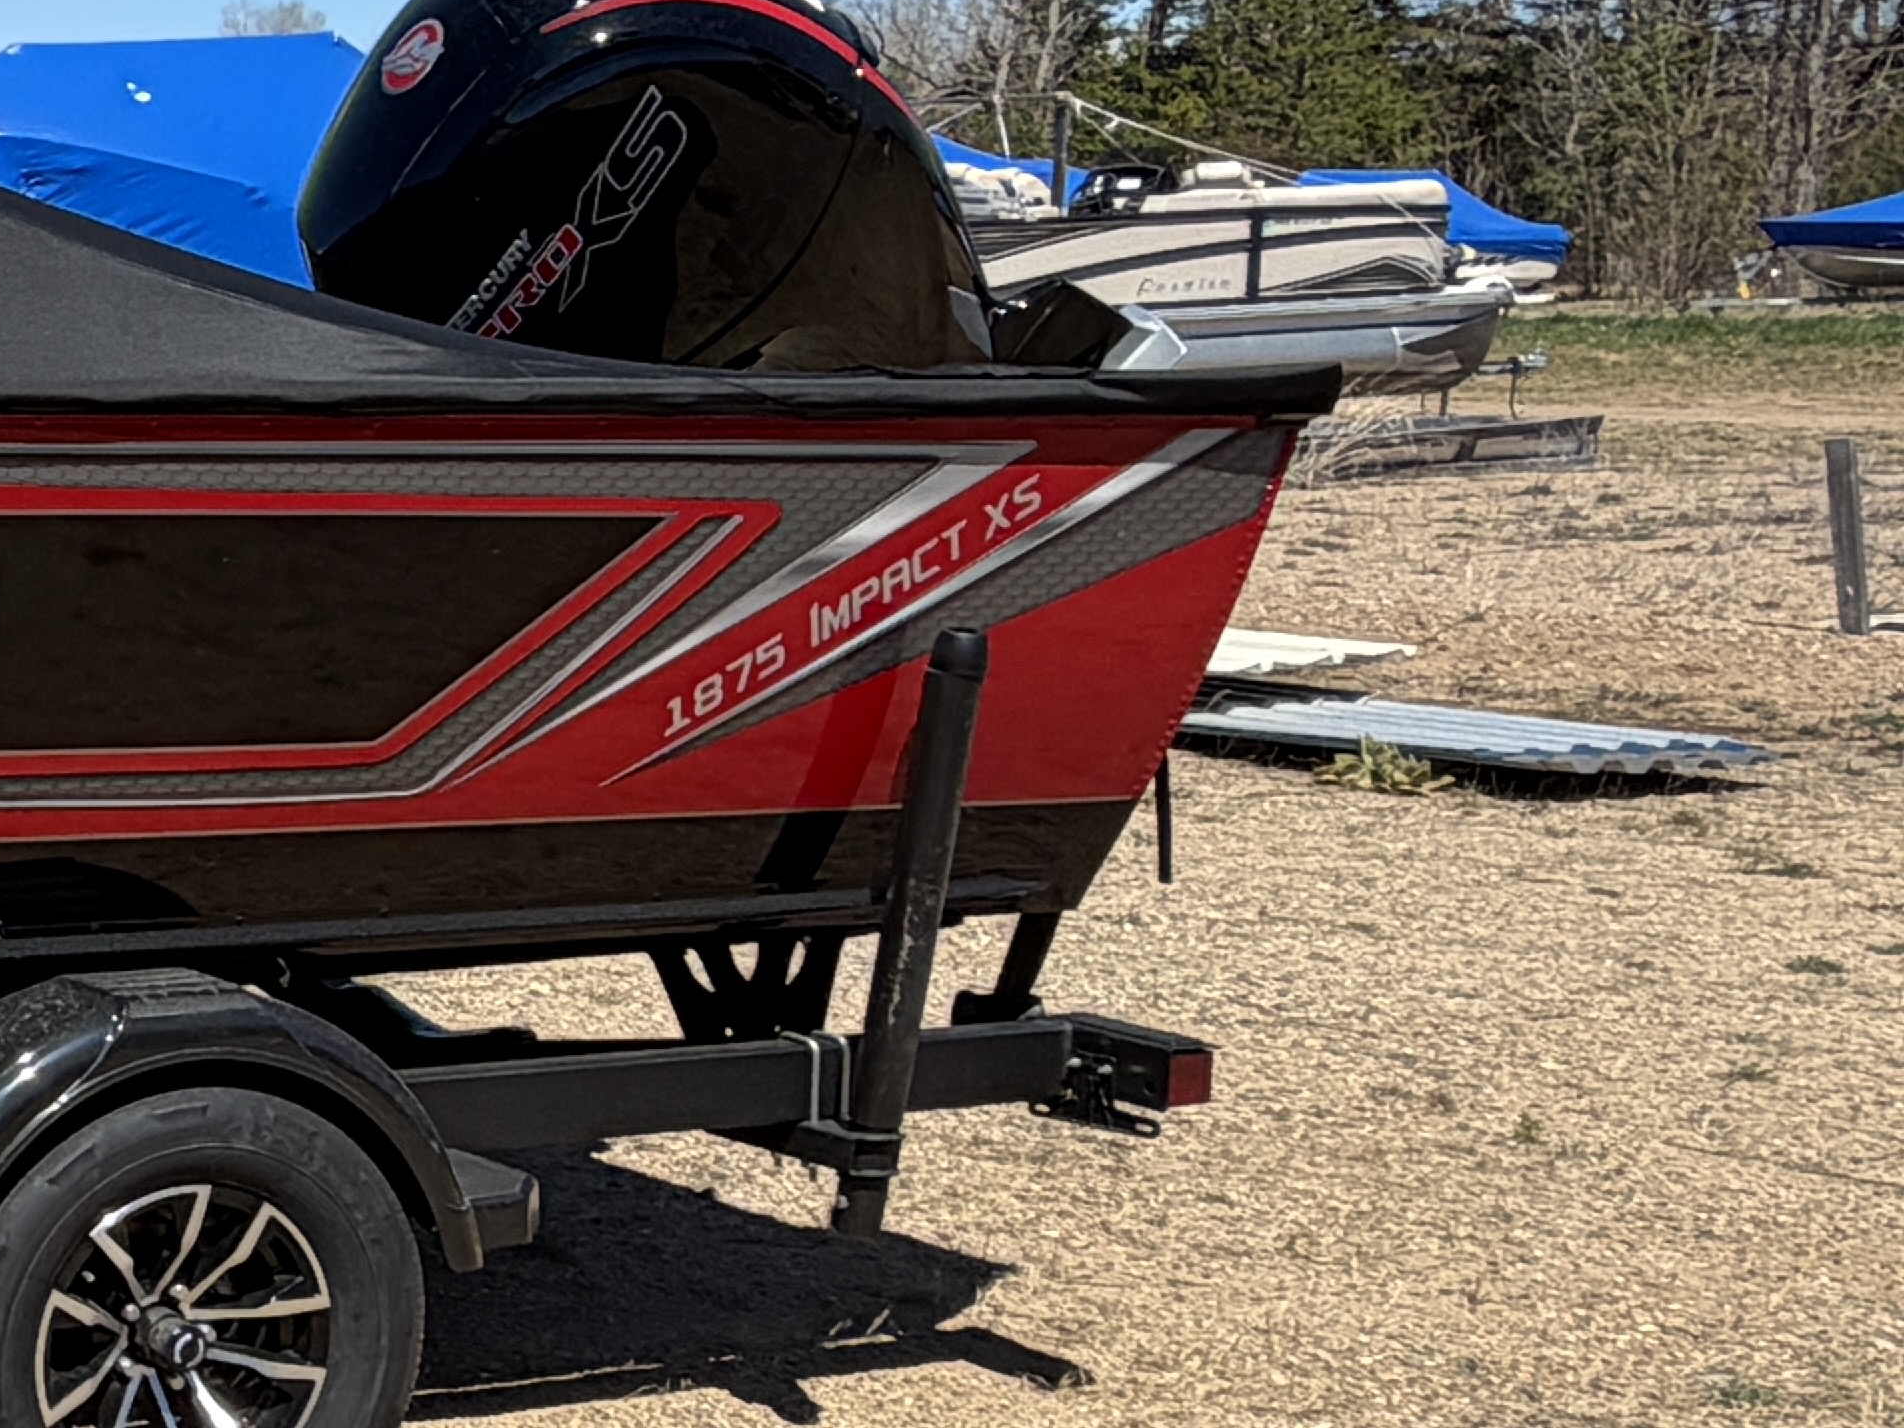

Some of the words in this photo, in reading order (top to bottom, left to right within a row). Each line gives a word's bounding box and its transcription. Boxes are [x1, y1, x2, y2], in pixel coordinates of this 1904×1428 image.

[445, 228, 532, 331] ERCURY
[663, 632, 786, 738] 1875
[809, 518, 968, 649] IMPACT
[984, 474, 1043, 541] XS
